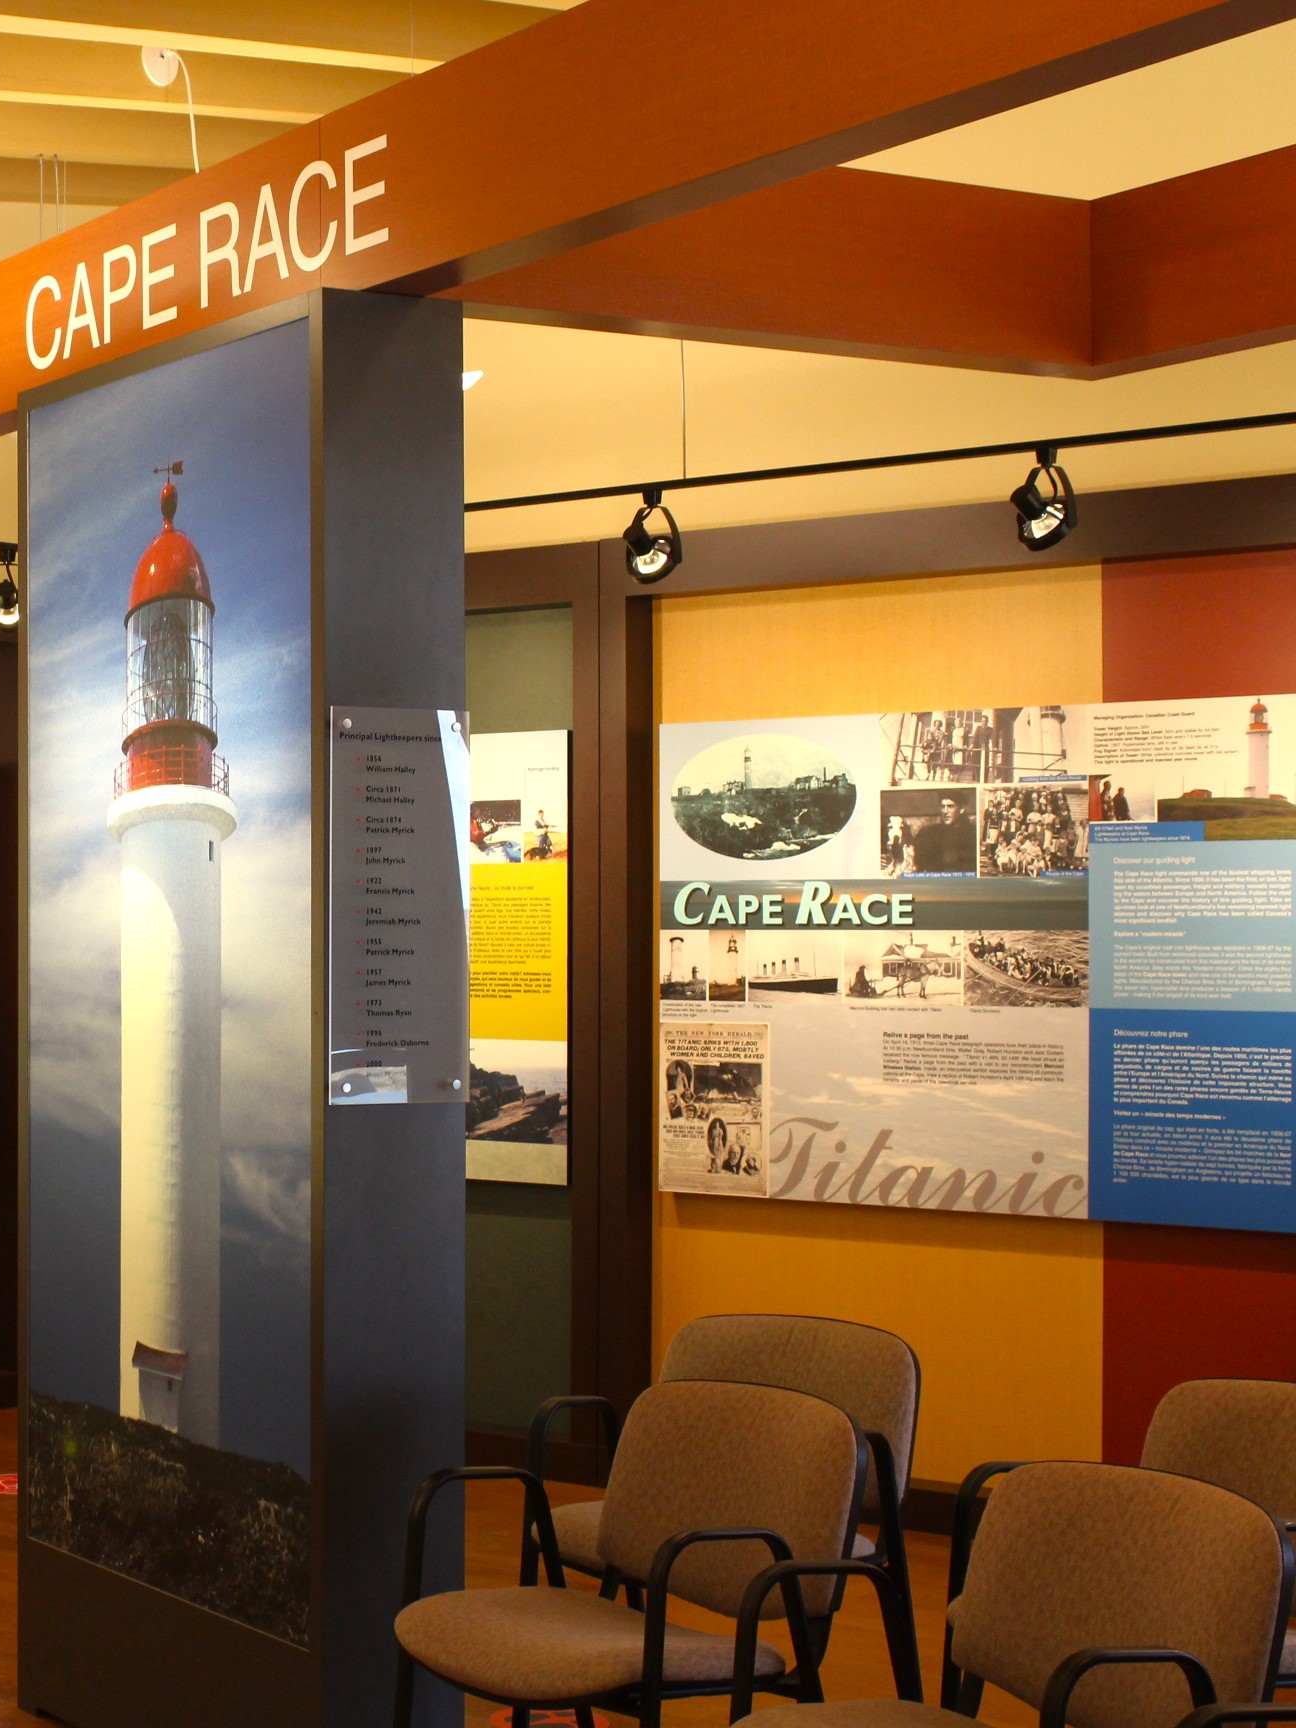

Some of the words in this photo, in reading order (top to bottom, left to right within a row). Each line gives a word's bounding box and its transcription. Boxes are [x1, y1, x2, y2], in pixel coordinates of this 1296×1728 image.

[26, 223, 177, 370] CAPE
[200, 134, 389, 309] RACE
[339, 732, 372, 741] Principal
[375, 733, 422, 742] Lightkeepers
[395, 766, 416, 775] Halley
[392, 827, 414, 835] Myrick
[365, 857, 381, 865] John
[1156, 857, 1179, 865] guiding
[1181, 856, 1195, 864] light
[674, 881, 783, 925] CAPE
[795, 881, 913, 925] RACE
[398, 918, 420, 926] Myrick
[1114, 1029, 1148, 1037] Découvrez
[769, 1117, 1088, 1217] Titanic
